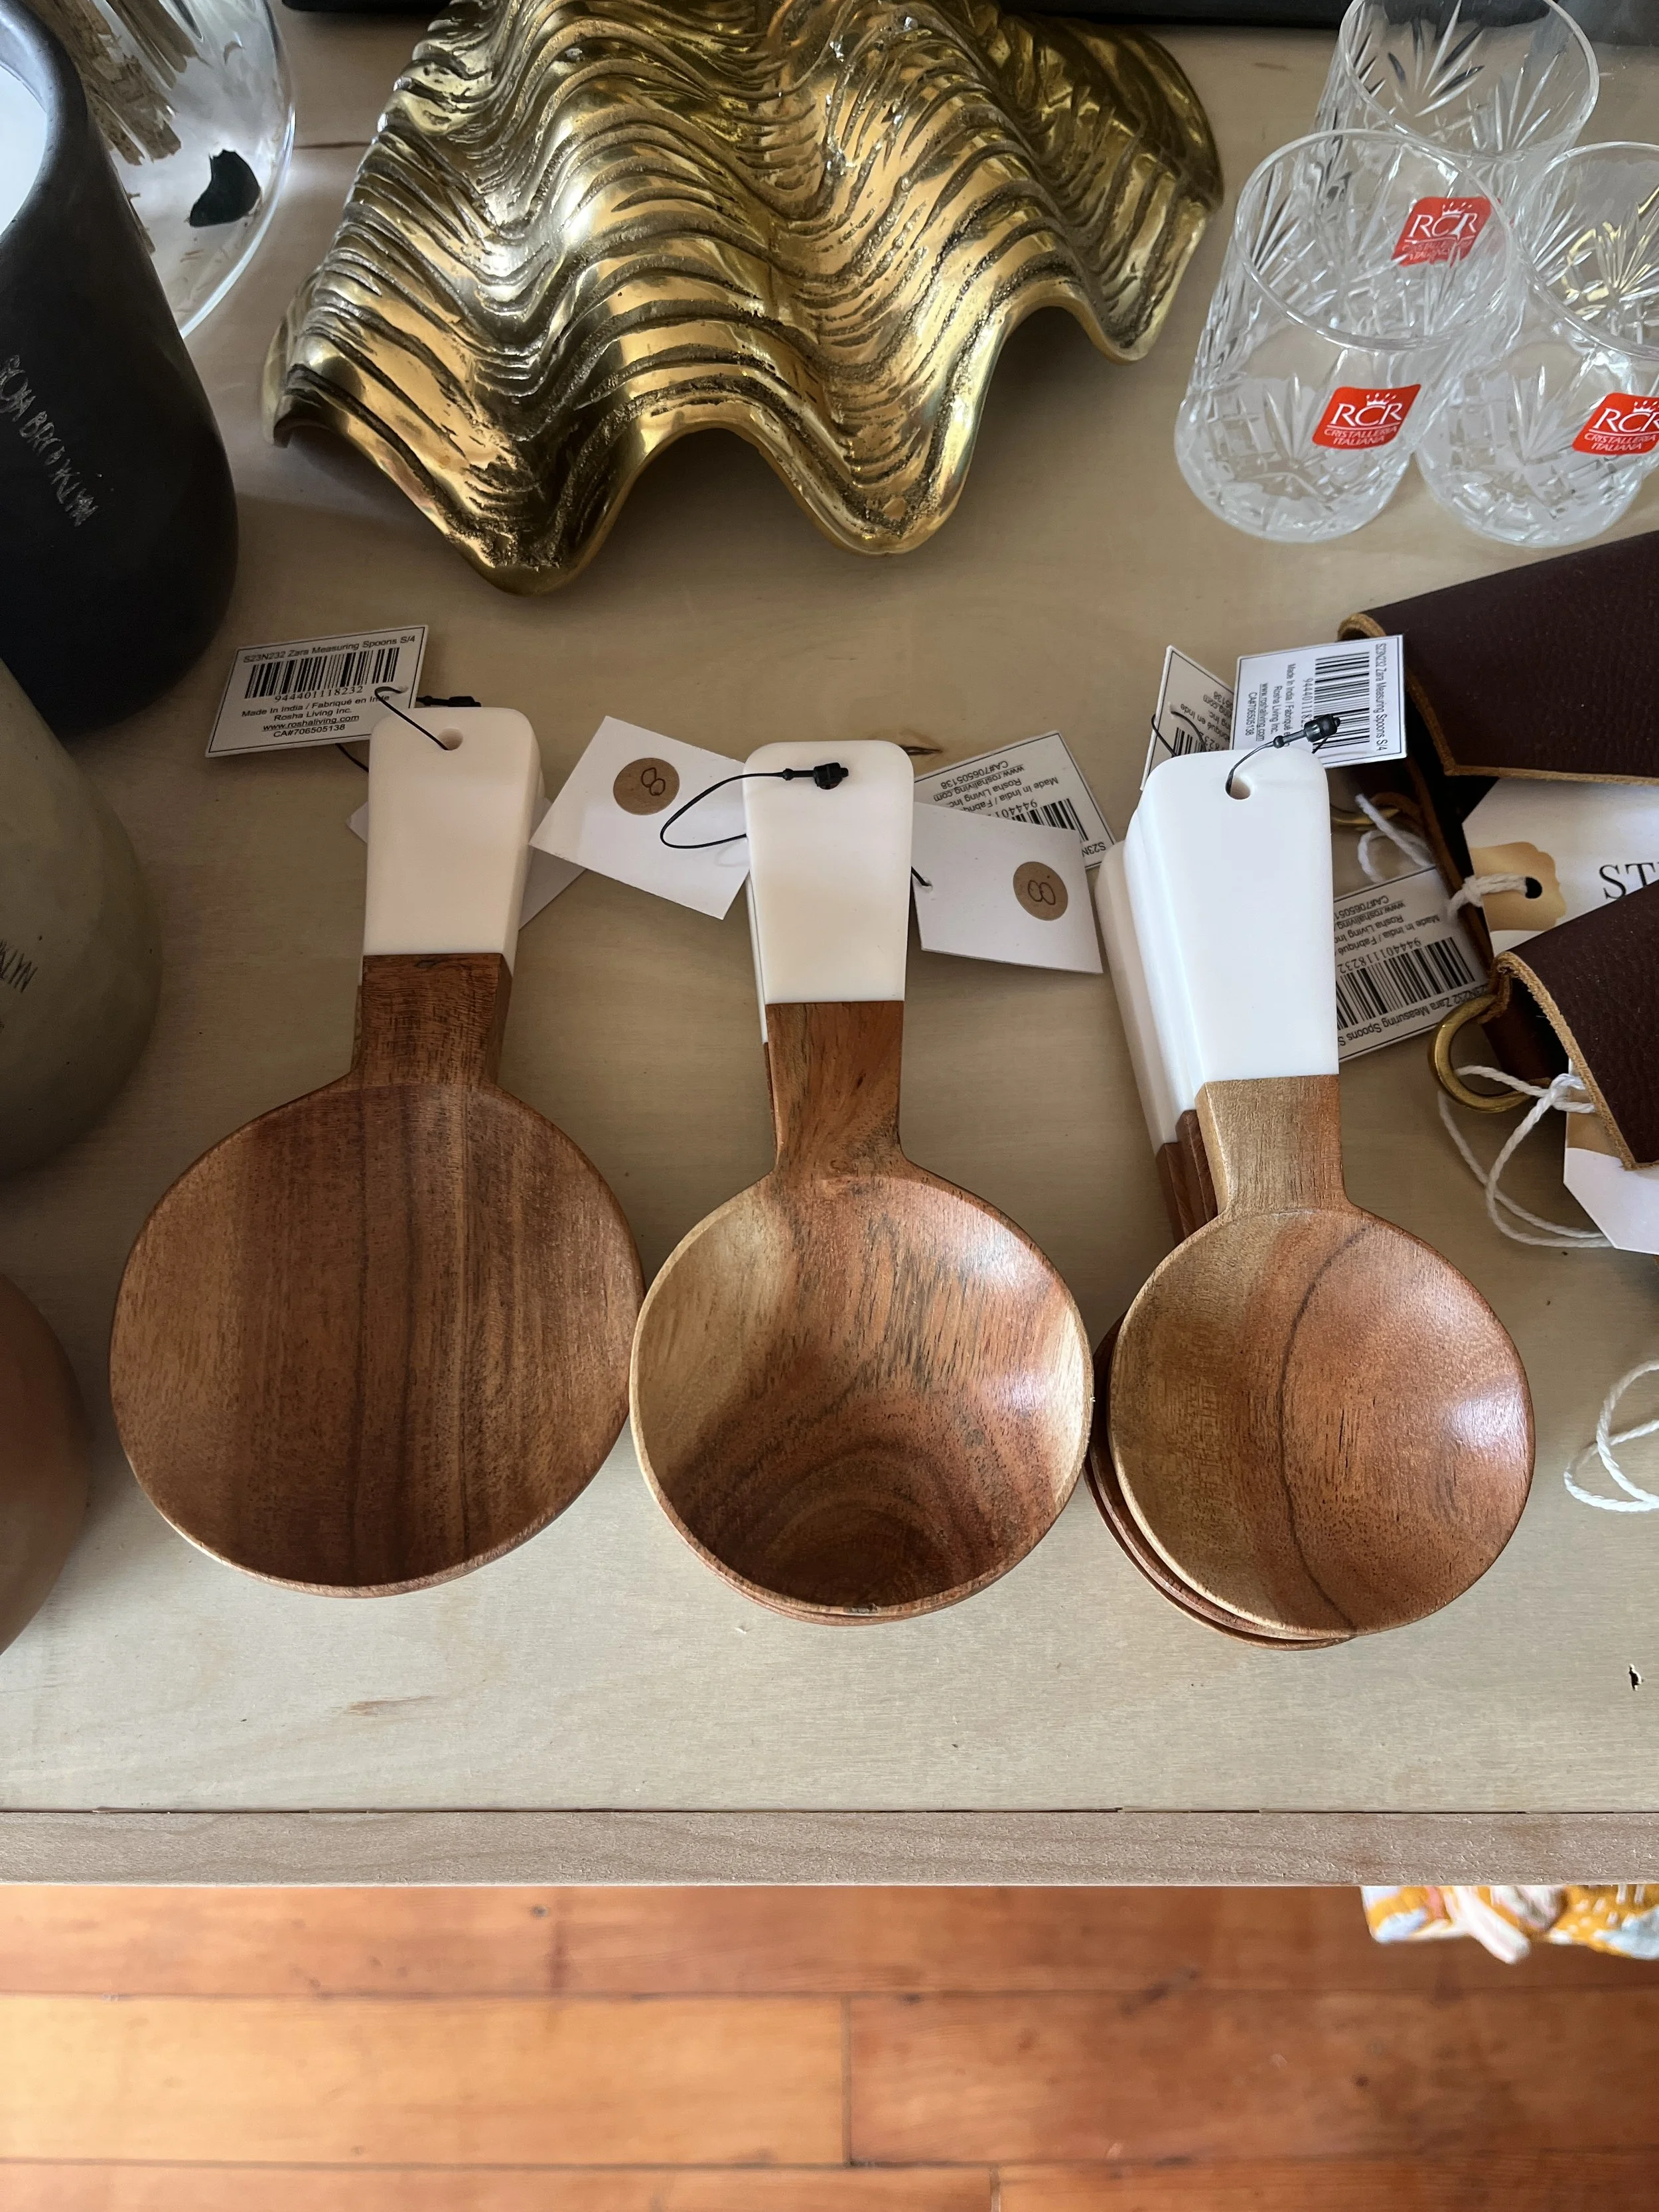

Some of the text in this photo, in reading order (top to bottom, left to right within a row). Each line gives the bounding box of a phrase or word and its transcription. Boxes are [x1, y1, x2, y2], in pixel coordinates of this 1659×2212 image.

[1408, 212, 1478, 238] RCR
[1330, 402, 1403, 427] RCR
[1593, 407, 1659, 433] RCR
[1333, 435, 1385, 446] ITALIANA
[1591, 442, 1642, 451] ITALIANA
[244, 651, 286, 663] S23N232
[312, 643, 359, 654] Measuring
[362, 639, 397, 648] Spoons
[400, 635, 415, 644] S/4
[1286, 664, 1296, 679] Made
[1376, 668, 1387, 682] Zara
[275, 686, 363, 703] 944401118232
[1285, 686, 1295, 701] India
[1301, 678, 1314, 728] 9444011182
[1373, 682, 1387, 713] Measuring
[312, 698, 352, 709] Fabriqué
[1181, 703, 1196, 719] Inde
[1256, 682, 1268, 741] www.roshaliving.com
[1269, 685, 1283, 735] Rosha Living Inc.
[307, 709, 333, 718] Living
[1197, 715, 1206, 724] en
[1245, 692, 1258, 736] CA#706505138
[1282, 704, 1294, 731] Fabriqué
[262, 715, 360, 732] www.roshaliving.com
[273, 724, 346, 738] CA#706505138
[1374, 714, 1388, 738] Spoons
[1376, 739, 1388, 751] S/4
[641, 767, 666, 796] 8
[933, 764, 1025, 802] www.roshaliving.com
[940, 761, 1009, 789] CA#706505138
[1033, 776, 1059, 789] Made
[992, 778, 1022, 792] Rosha
[964, 788, 991, 802] Living
[998, 789, 1022, 801] India
[1082, 842, 1107, 857] S23N
[1599, 862, 1659, 900] ST
[1027, 879, 1056, 905] 8
[1334, 895, 1390, 920] CA#7065051
[1334, 915, 1404, 944] Rosha Living Inc
[1415, 914, 1440, 927] Made
[1382, 926, 1405, 938] India
[1337, 937, 1421, 974] 944401118232
[1338, 936, 1377, 956] Fabriqué
[1430, 997, 1453, 1010] Zara
[1381, 1005, 1431, 1028] Measuring
[1347, 1022, 1382, 1041] Spoons
